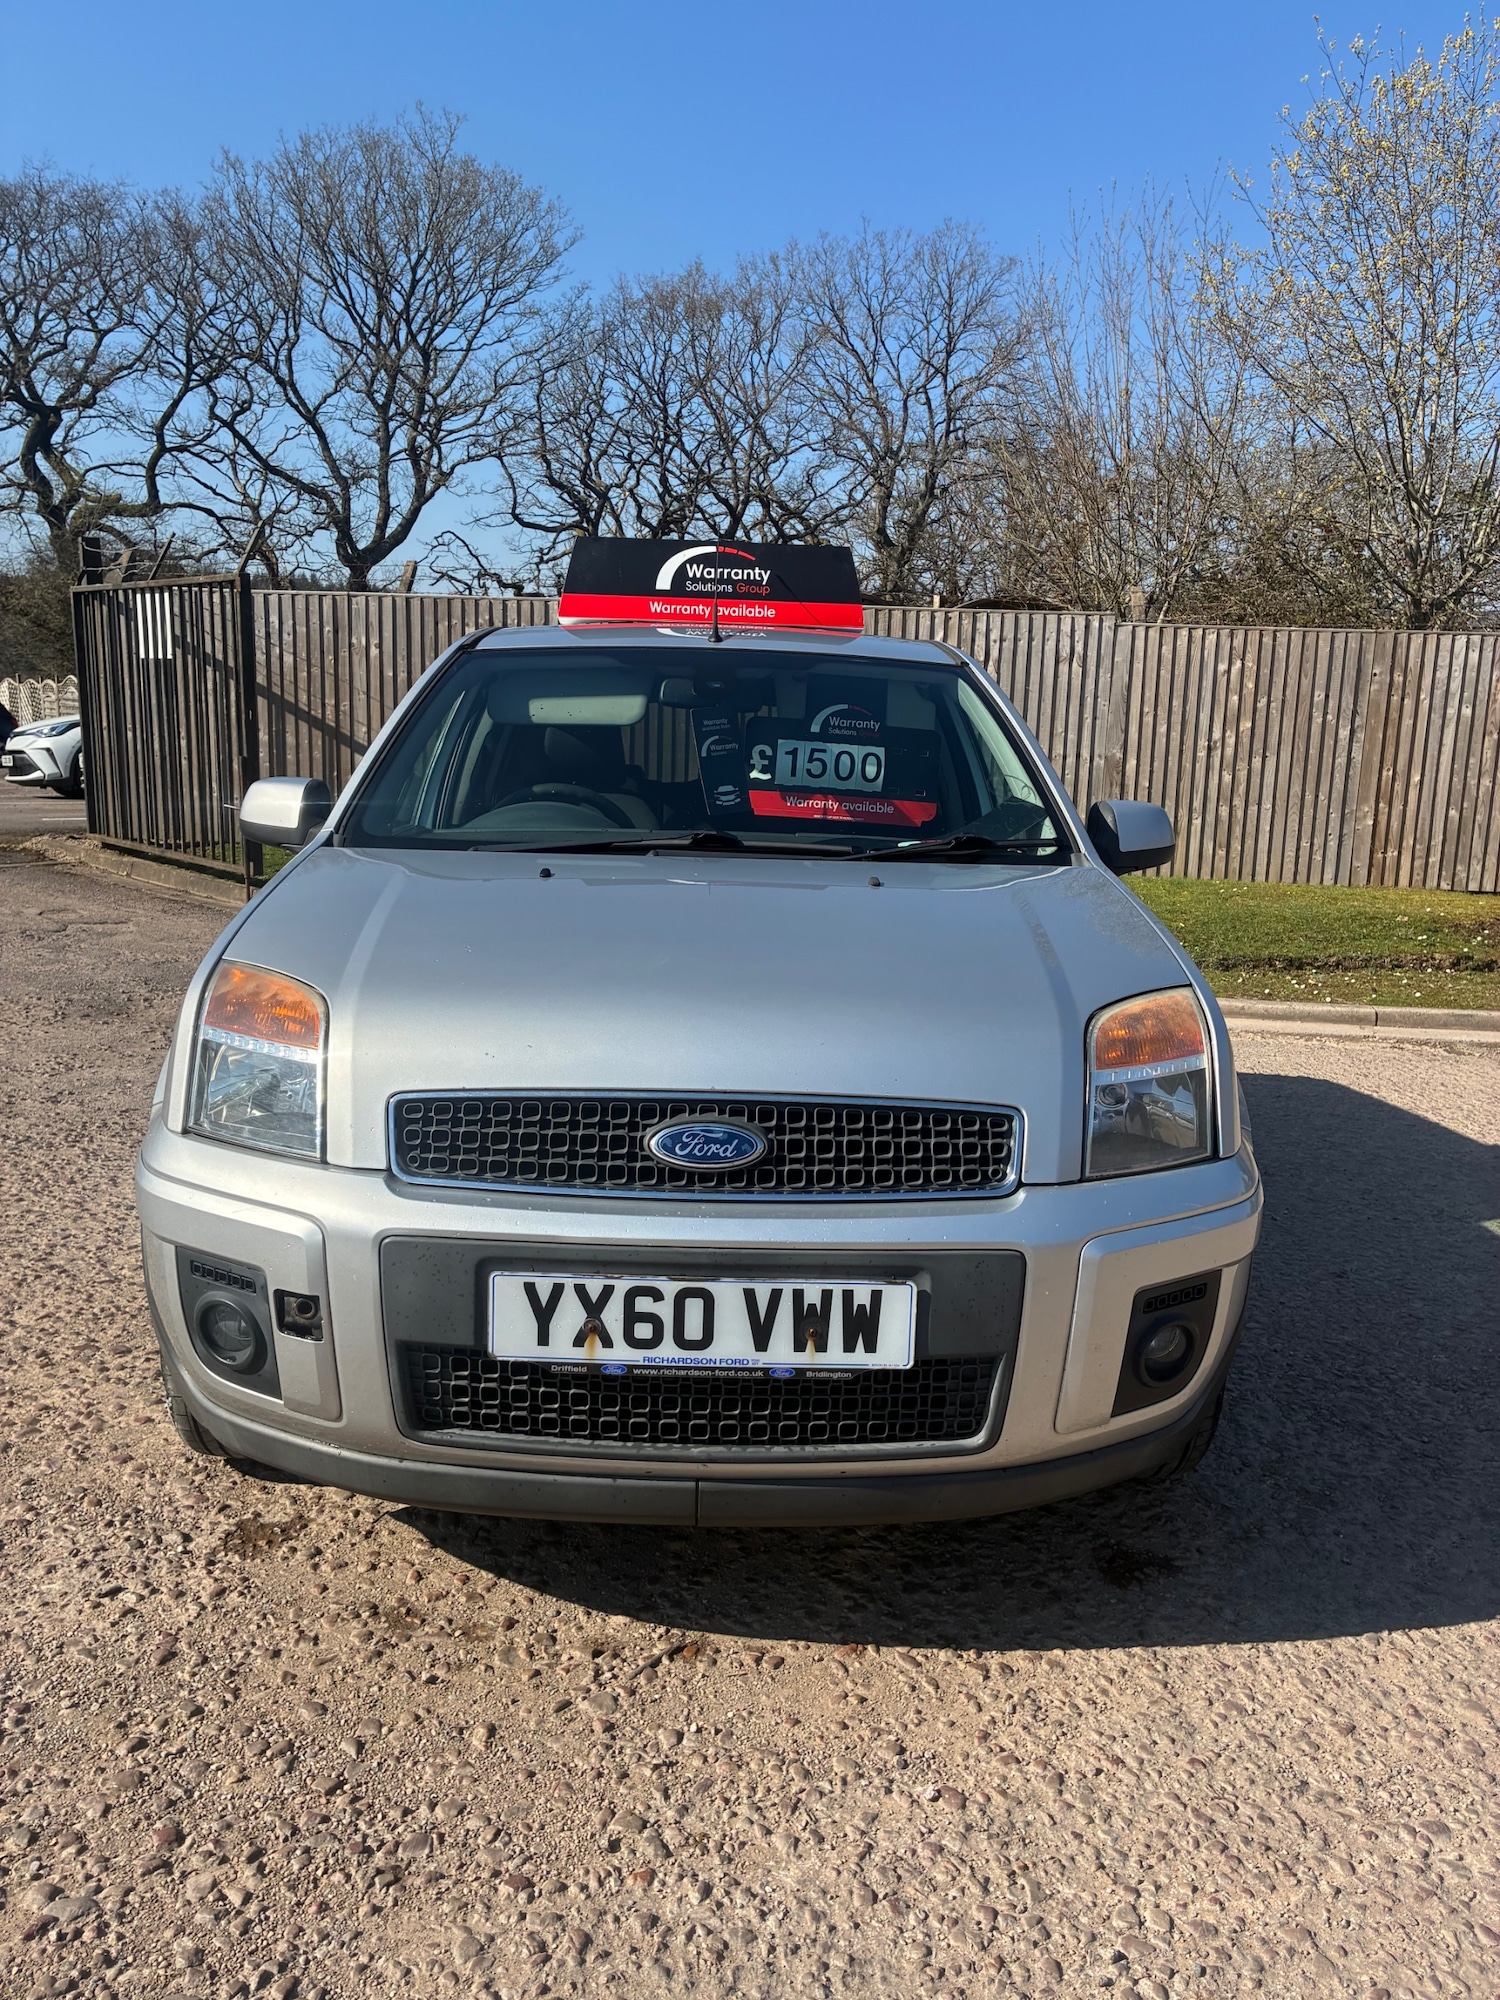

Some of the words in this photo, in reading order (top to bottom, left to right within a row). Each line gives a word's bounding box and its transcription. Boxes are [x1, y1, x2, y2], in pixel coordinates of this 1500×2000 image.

[686, 563, 771, 585] Warranty
[685, 581, 733, 593] Solutions
[736, 582, 770, 596] Group
[649, 601, 711, 618] Warranty
[717, 604, 776, 618] available
[828, 727, 857, 736] Solutions
[829, 716, 880, 732] Warranty
[710, 743, 739, 751] Warranty
[786, 796, 839, 812] Warranty
[841, 801, 895, 814] available
[675, 1130, 740, 1157] Ford
[523, 1282, 715, 1351] YX60
[742, 1288, 882, 1354] VWW
[642, 1356, 718, 1365] RICHARDSON
[719, 1358, 750, 1366] FORD
[551, 1365, 588, 1373] Driffield
[632, 1367, 764, 1377] www.richardson-ford.co.uk
[806, 1371, 852, 1380] Bridlington
